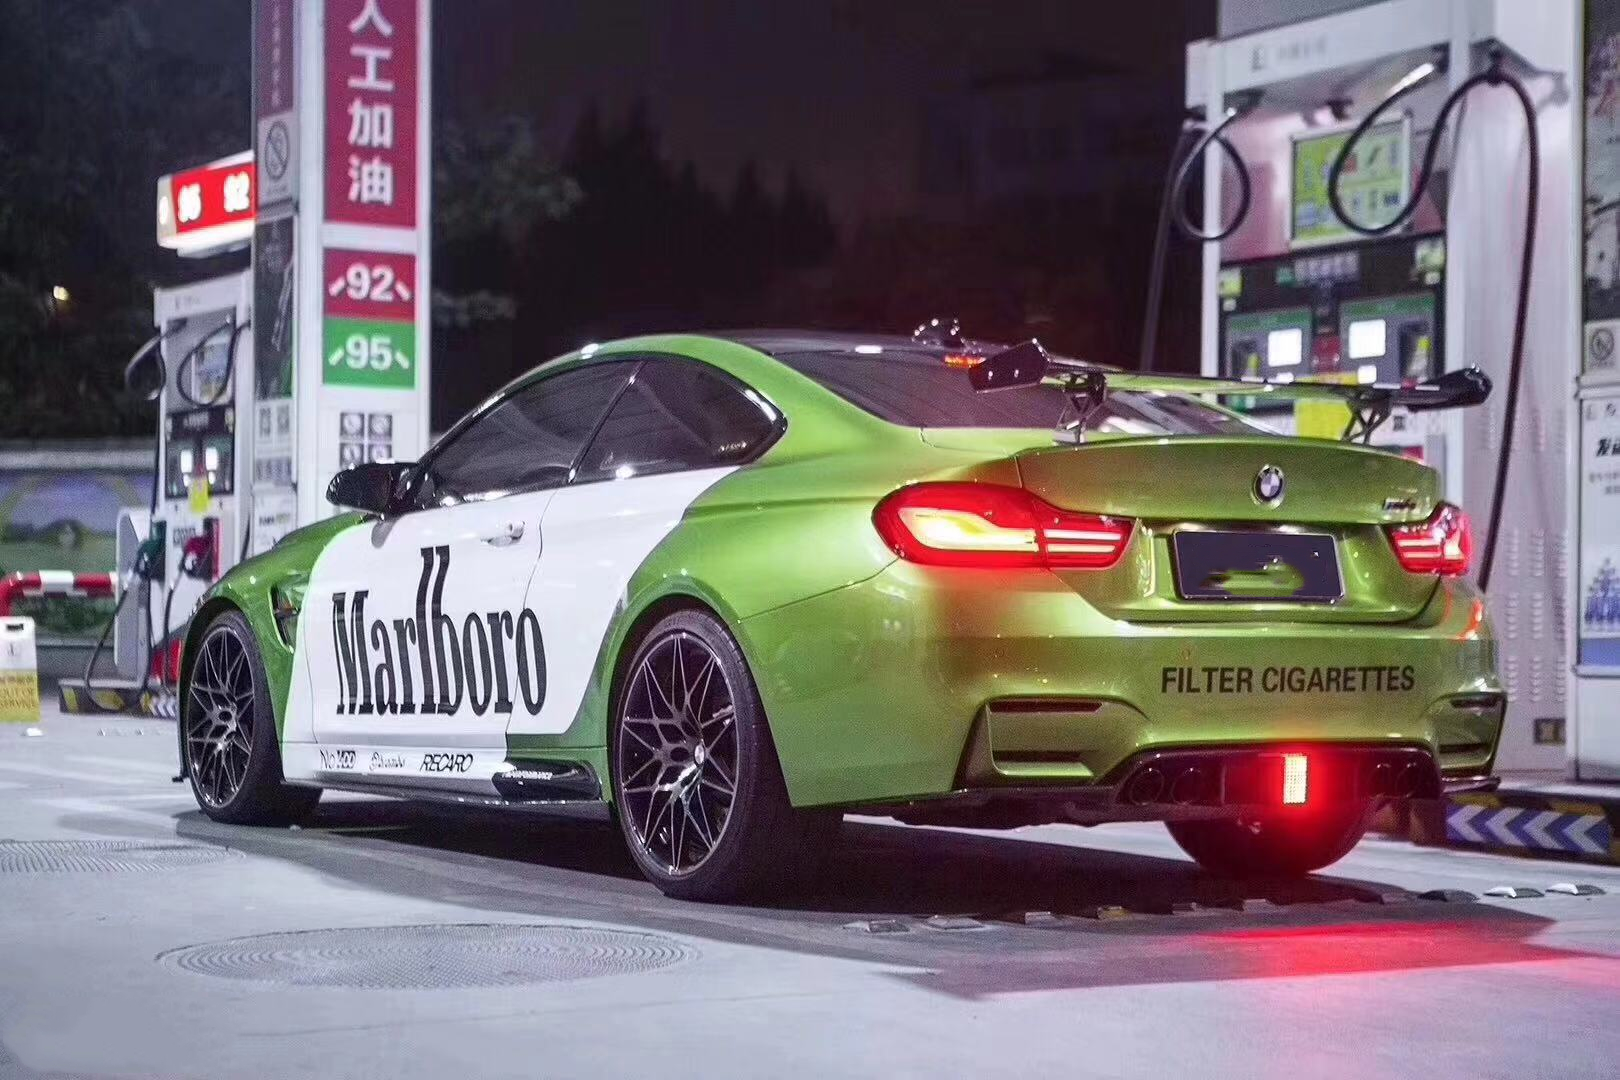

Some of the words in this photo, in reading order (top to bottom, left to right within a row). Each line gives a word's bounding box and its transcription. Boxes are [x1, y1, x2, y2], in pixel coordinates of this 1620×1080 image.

[347, 0, 395, 206] 人工加油
[345, 263, 395, 303] 92
[345, 334, 394, 372] 95
[332, 544, 547, 717] Marlboro
[1161, 667, 1253, 693] FILTER
[1262, 665, 1415, 693] CIGARETTES
[419, 753, 473, 773] RECARO
